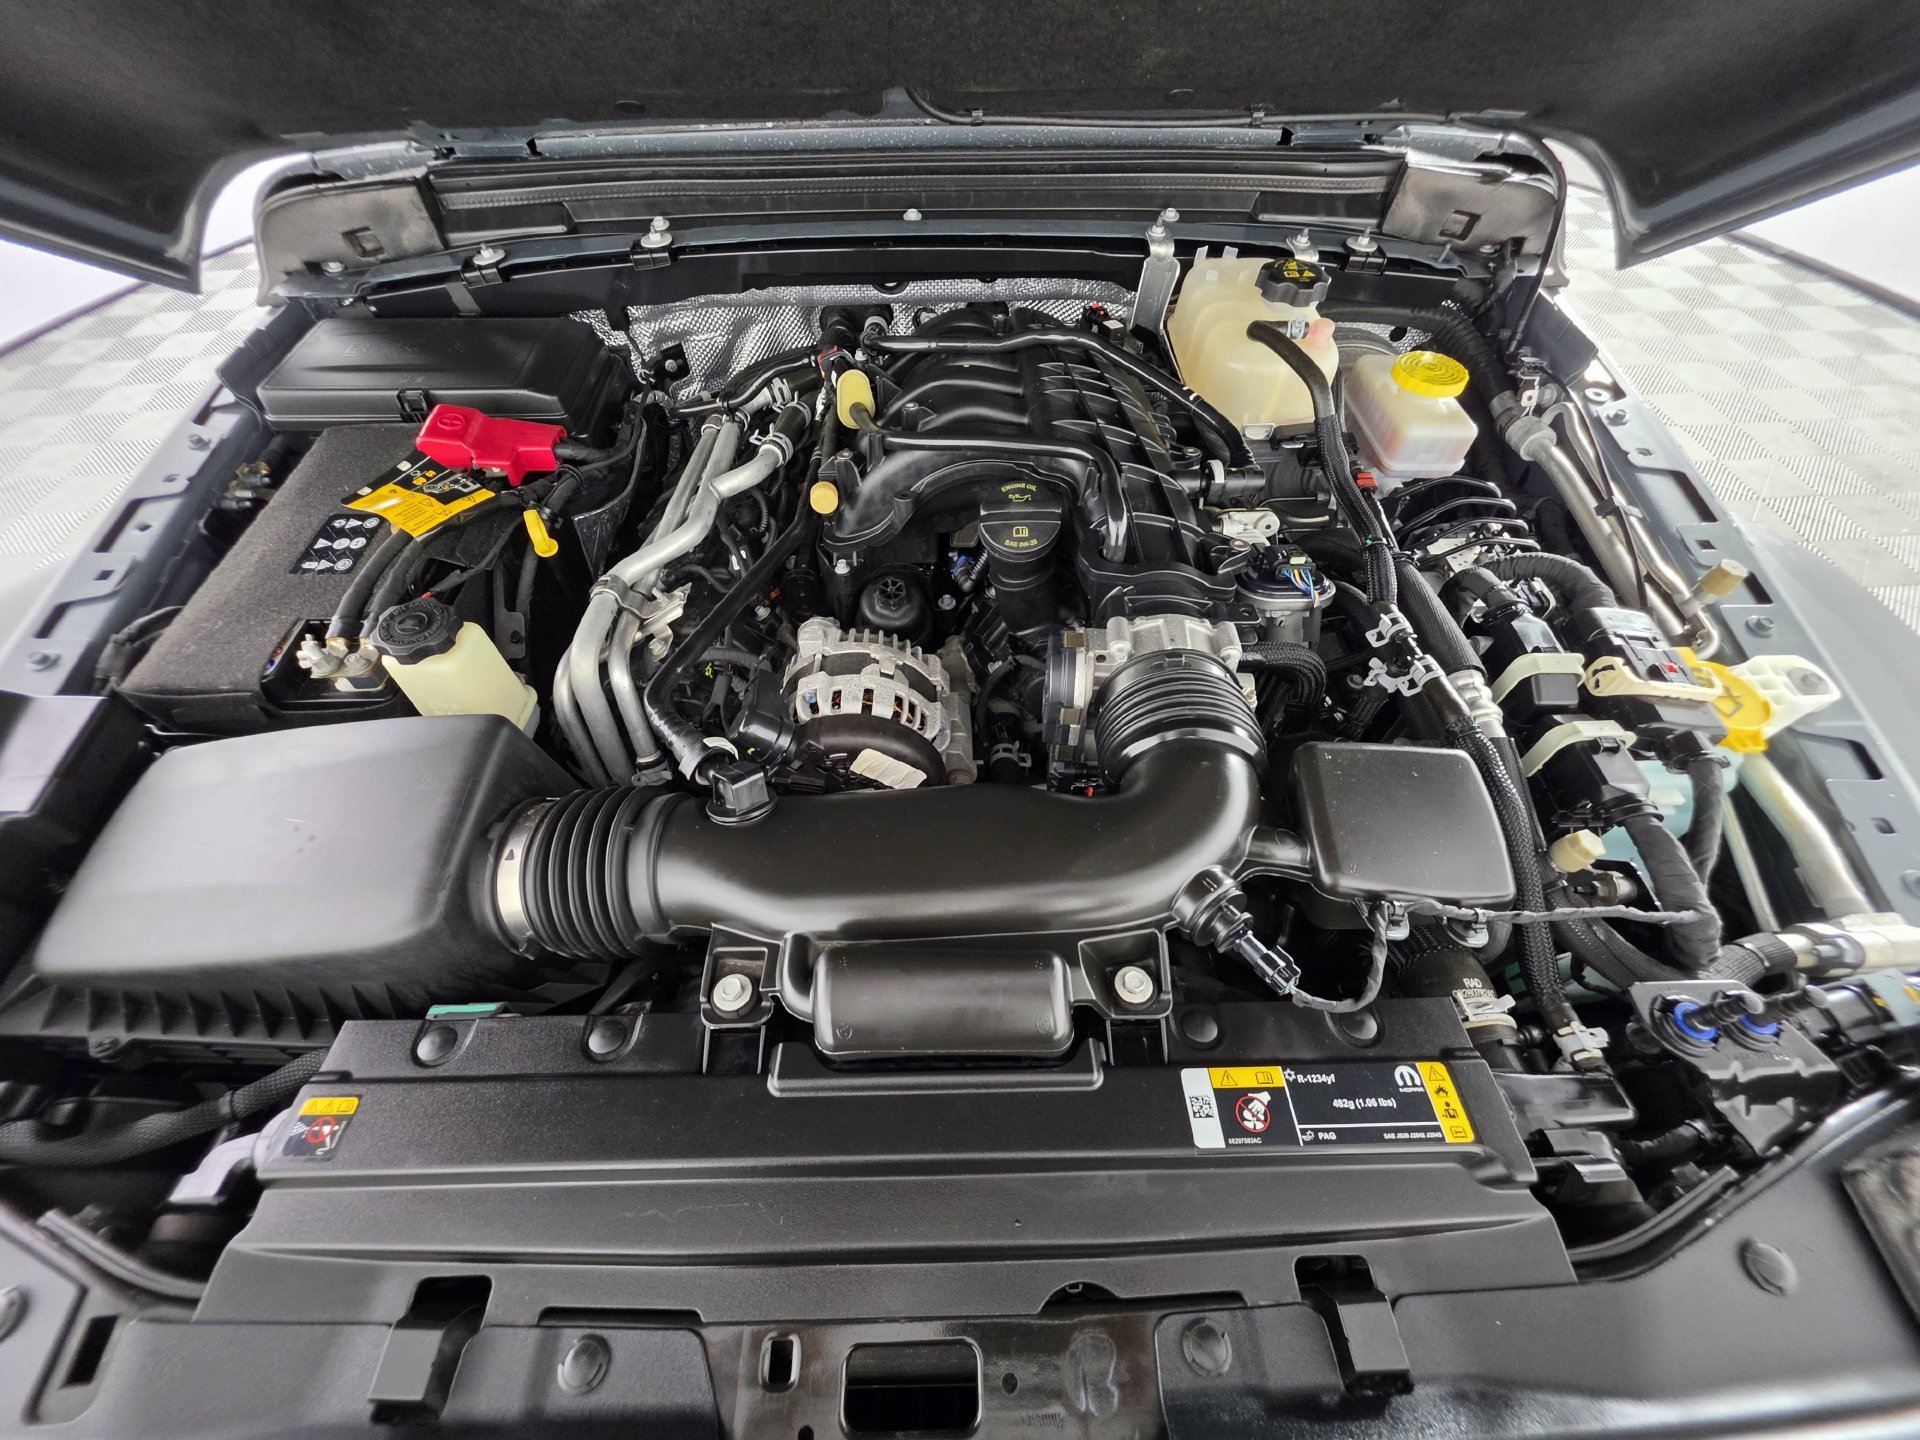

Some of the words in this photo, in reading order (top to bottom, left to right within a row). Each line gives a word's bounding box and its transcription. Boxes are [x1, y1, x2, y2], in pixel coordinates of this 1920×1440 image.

[1001, 483, 1026, 492] ENGINE
[1026, 484, 1037, 492] OIL
[1005, 539, 1018, 547] SAE
[1019, 538, 1038, 548] 0W-20
[1462, 977, 1483, 988] RAD
[1296, 1073, 1336, 1085] R-1234yf
[1332, 1098, 1355, 1110] 482g
[1378, 1097, 1397, 1109] lbs)
[1317, 1131, 1337, 1140] PAG
